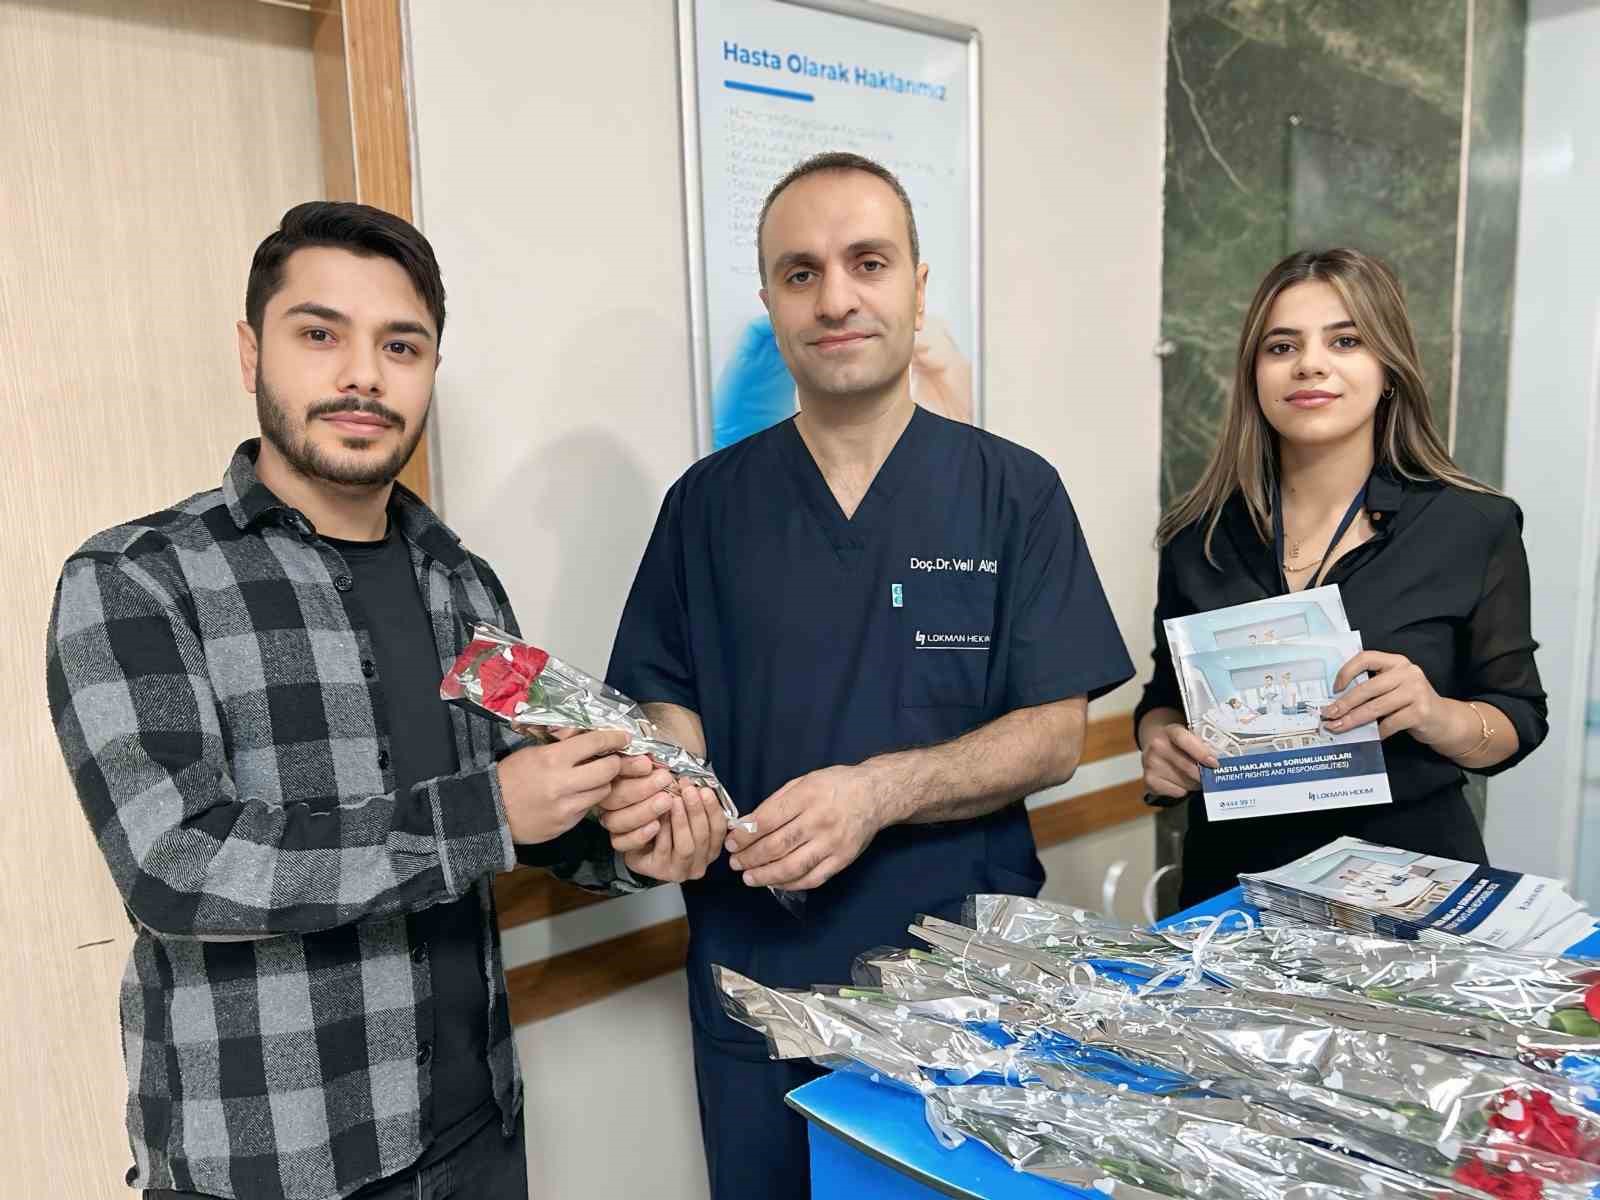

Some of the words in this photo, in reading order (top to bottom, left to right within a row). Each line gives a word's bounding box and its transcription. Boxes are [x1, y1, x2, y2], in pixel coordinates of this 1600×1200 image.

[723, 41, 781, 70] Hasta
[787, 54, 849, 81] Olarak
[927, 634, 966, 642] LOKMAN
[1214, 766, 1238, 774] HASTA
[1239, 762, 1272, 771] HAKLARI
[1215, 773, 1243, 783] (PATIENT
[1245, 771, 1270, 780] RIGHTS
[1271, 769, 1286, 777] AND
[1286, 762, 1350, 775] RESPONSIBILITIES)
[1316, 791, 1348, 799] LOKMAN
